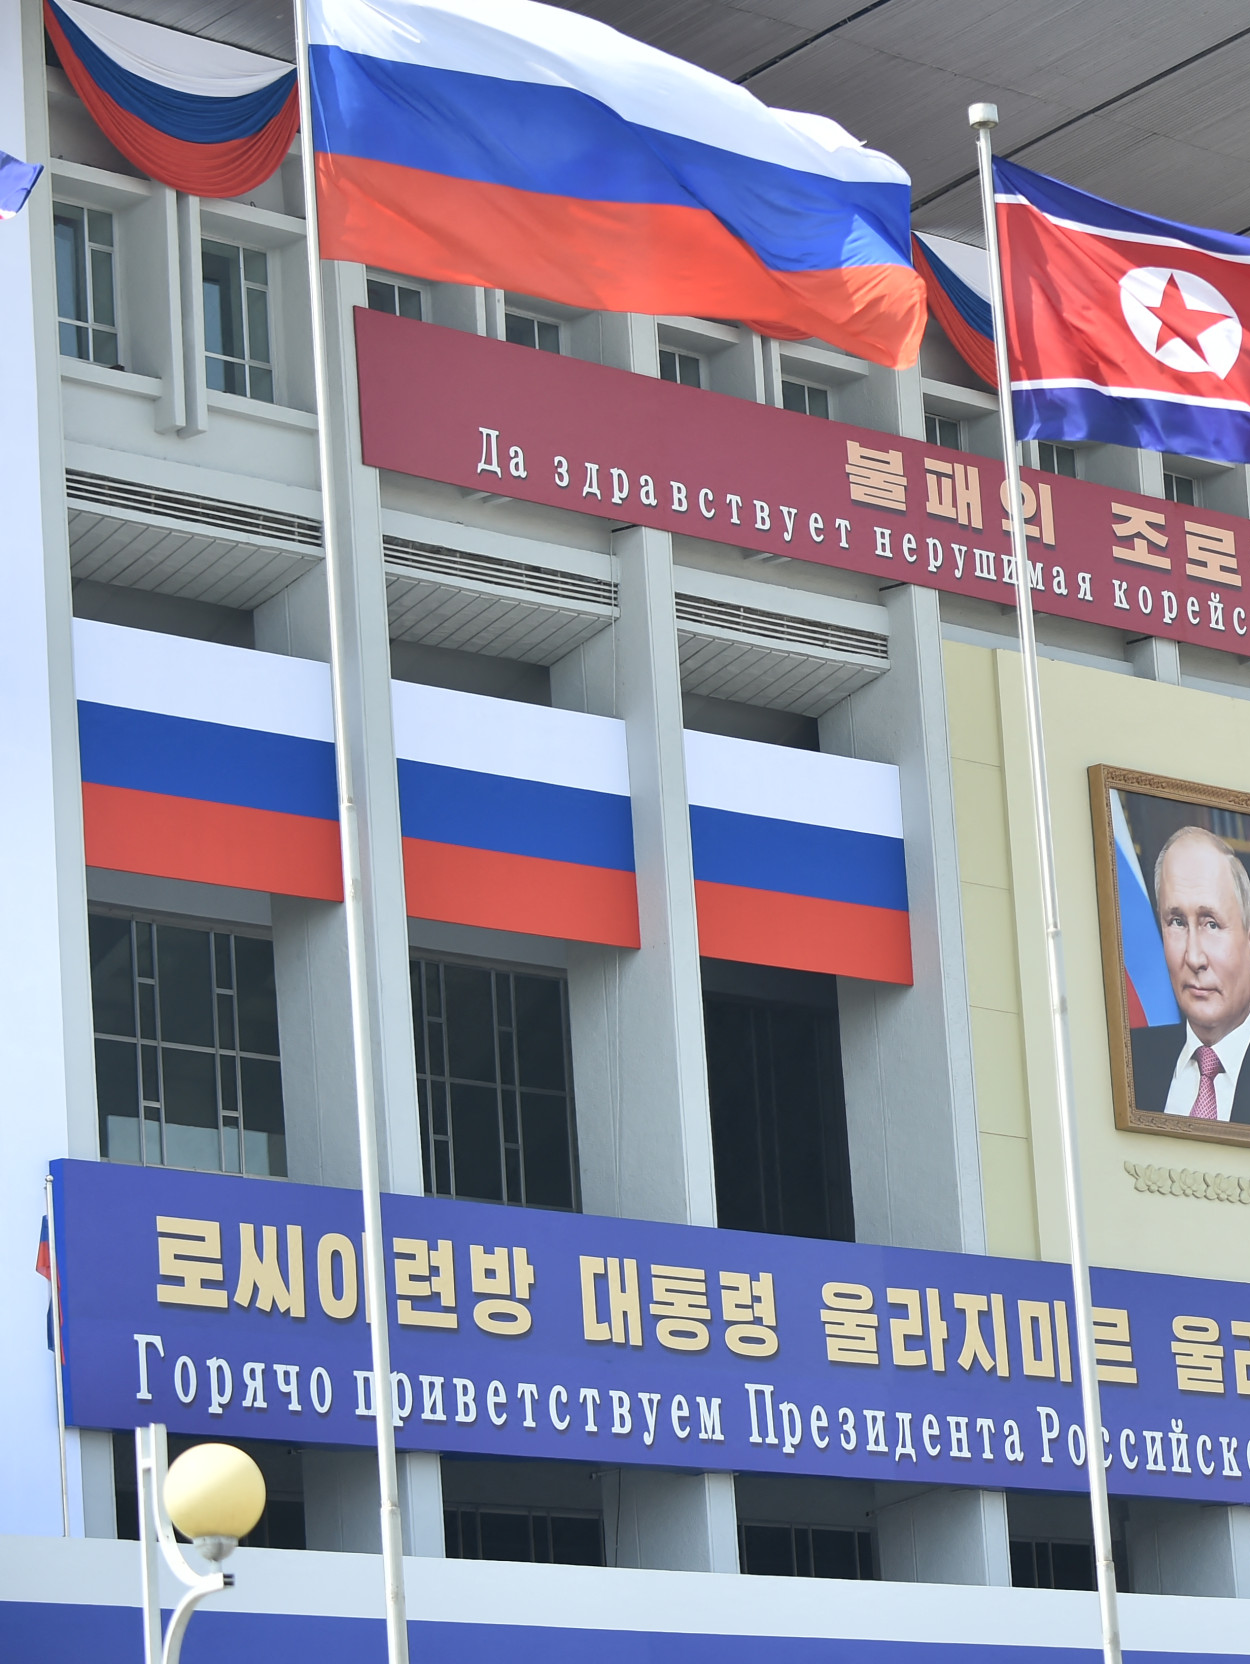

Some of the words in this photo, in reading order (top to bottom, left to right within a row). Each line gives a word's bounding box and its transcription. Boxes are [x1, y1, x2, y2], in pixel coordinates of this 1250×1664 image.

[477, 426, 528, 479] Да
[553, 455, 851, 549] здравствует
[873, 526, 1094, 601] нерушимая
[845, 440, 1056, 546] 불패의
[156, 1215, 535, 1335] 로씨아련방
[580, 1255, 779, 1357] 대통령
[820, 1281, 1138, 1384] 울라지미르
[133, 1333, 332, 1414] Горячо
[353, 1370, 725, 1446] приветствуем
[744, 1382, 1025, 1463] Президента
